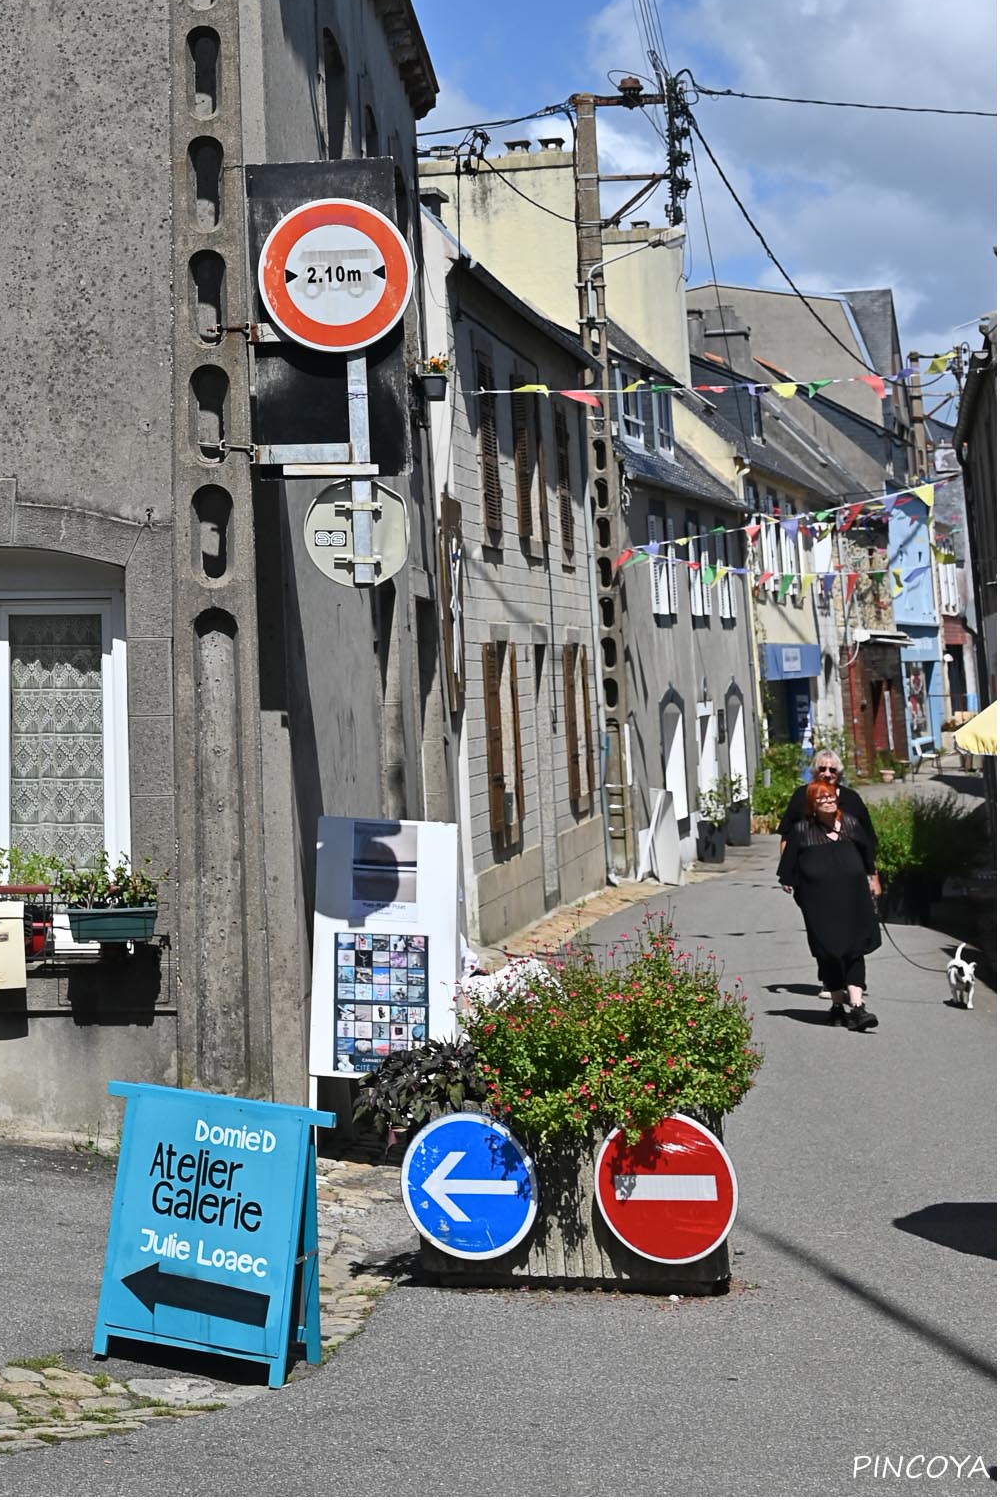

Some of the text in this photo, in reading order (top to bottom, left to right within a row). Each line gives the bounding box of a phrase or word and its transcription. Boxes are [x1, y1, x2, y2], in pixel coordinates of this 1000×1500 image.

[307, 265, 362, 284] 2.10m
[149, 1142, 243, 1190] Atelier
[152, 1180, 263, 1232] Galerie
[140, 1228, 268, 1277] Julie Loaec
